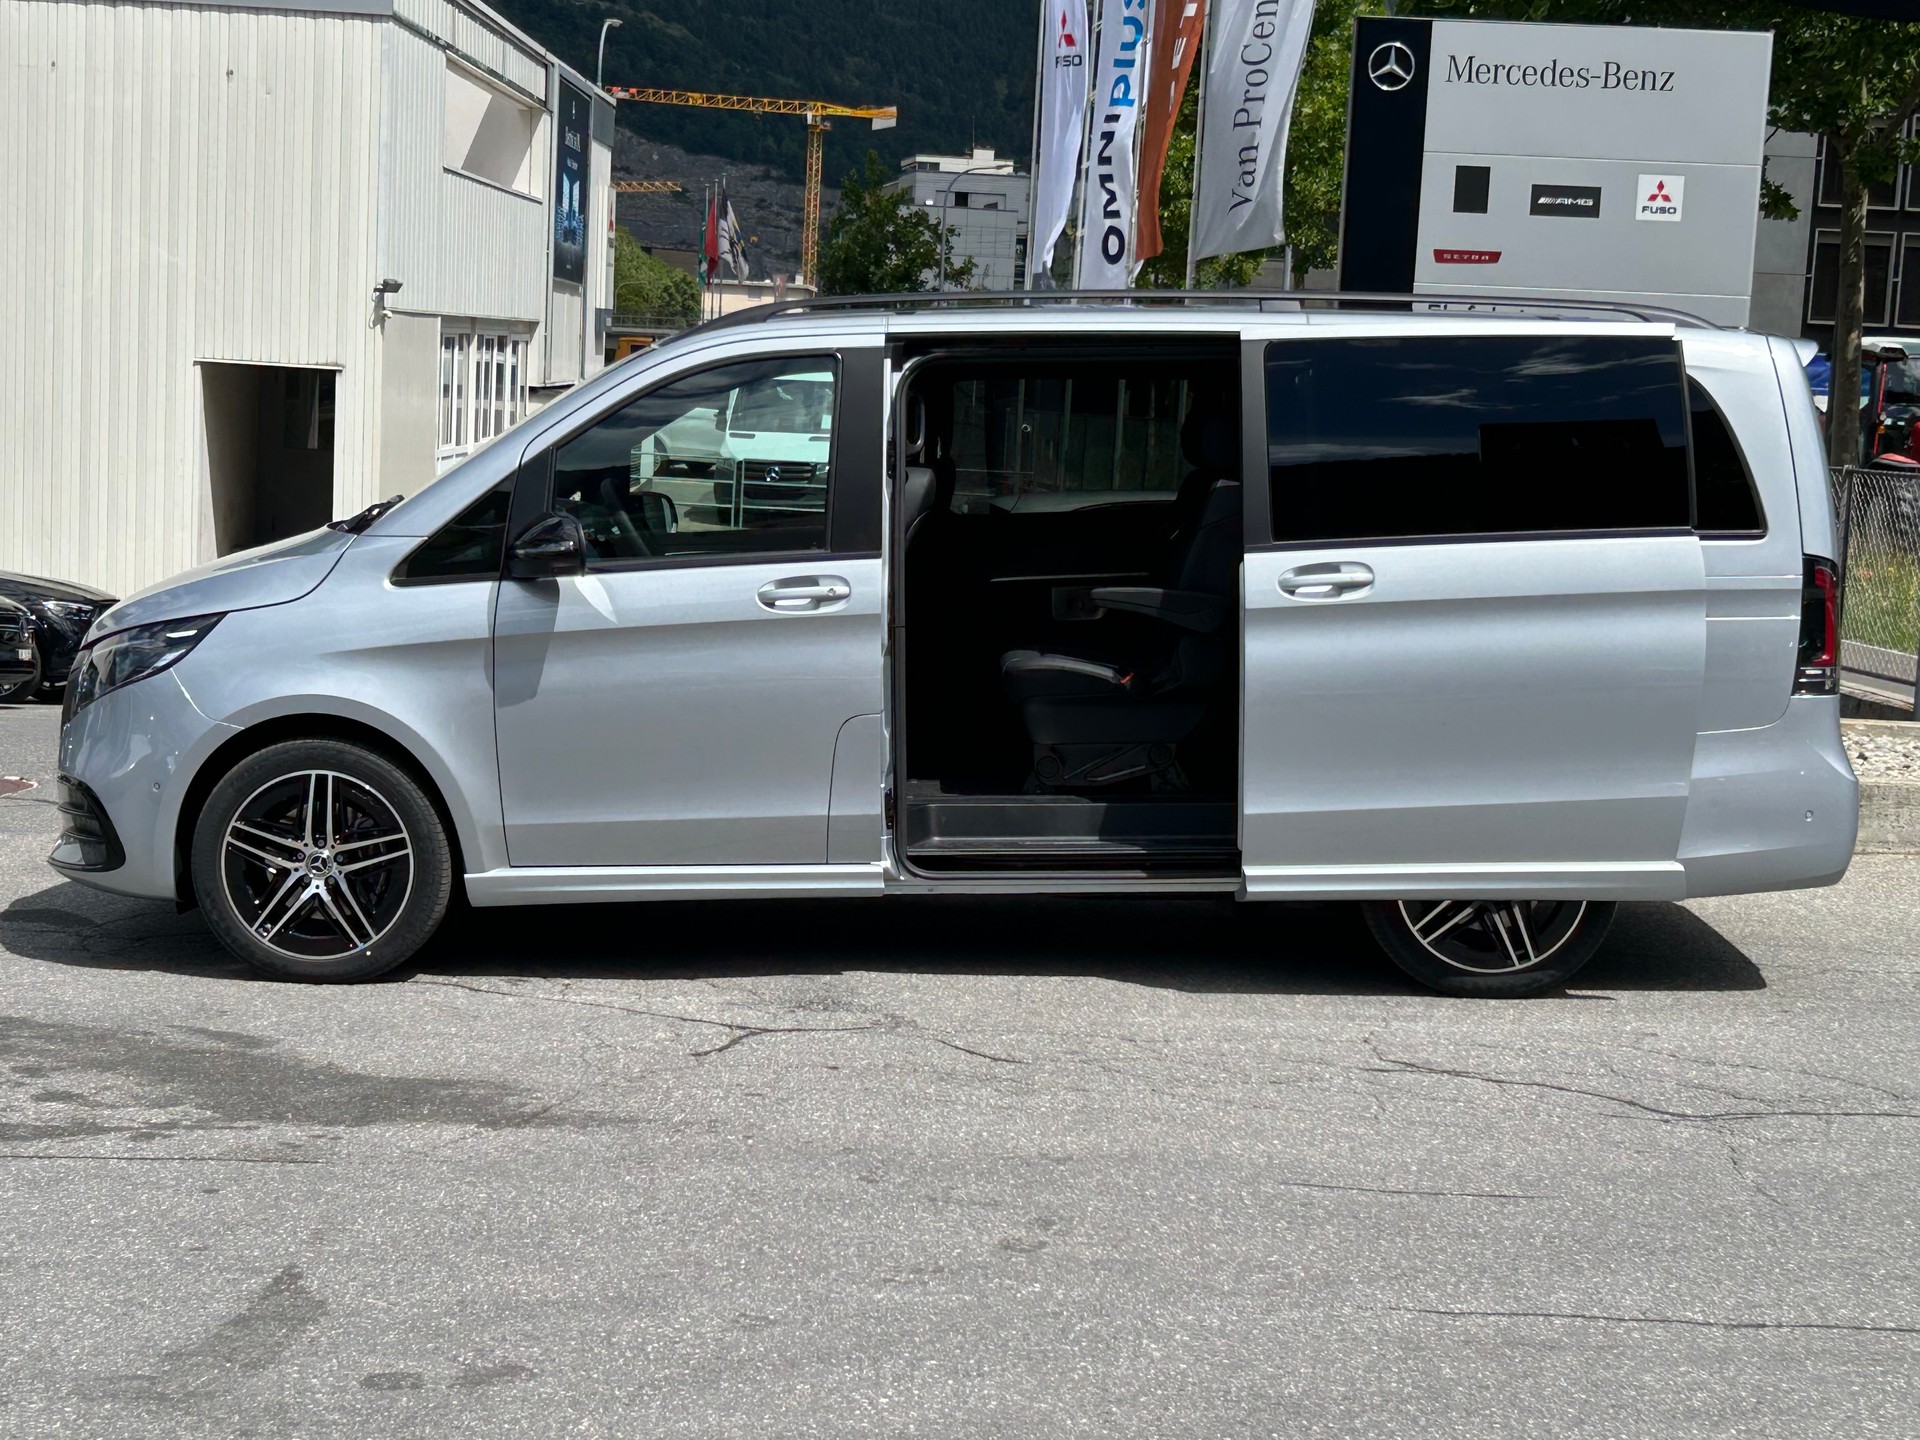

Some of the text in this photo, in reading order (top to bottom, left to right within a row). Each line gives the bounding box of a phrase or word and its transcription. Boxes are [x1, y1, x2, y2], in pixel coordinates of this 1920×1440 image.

[1445, 55, 1675, 92] Mercedes-Benz
[1227, 142, 1259, 216] Van
[1642, 206, 1677, 215] FUSO
